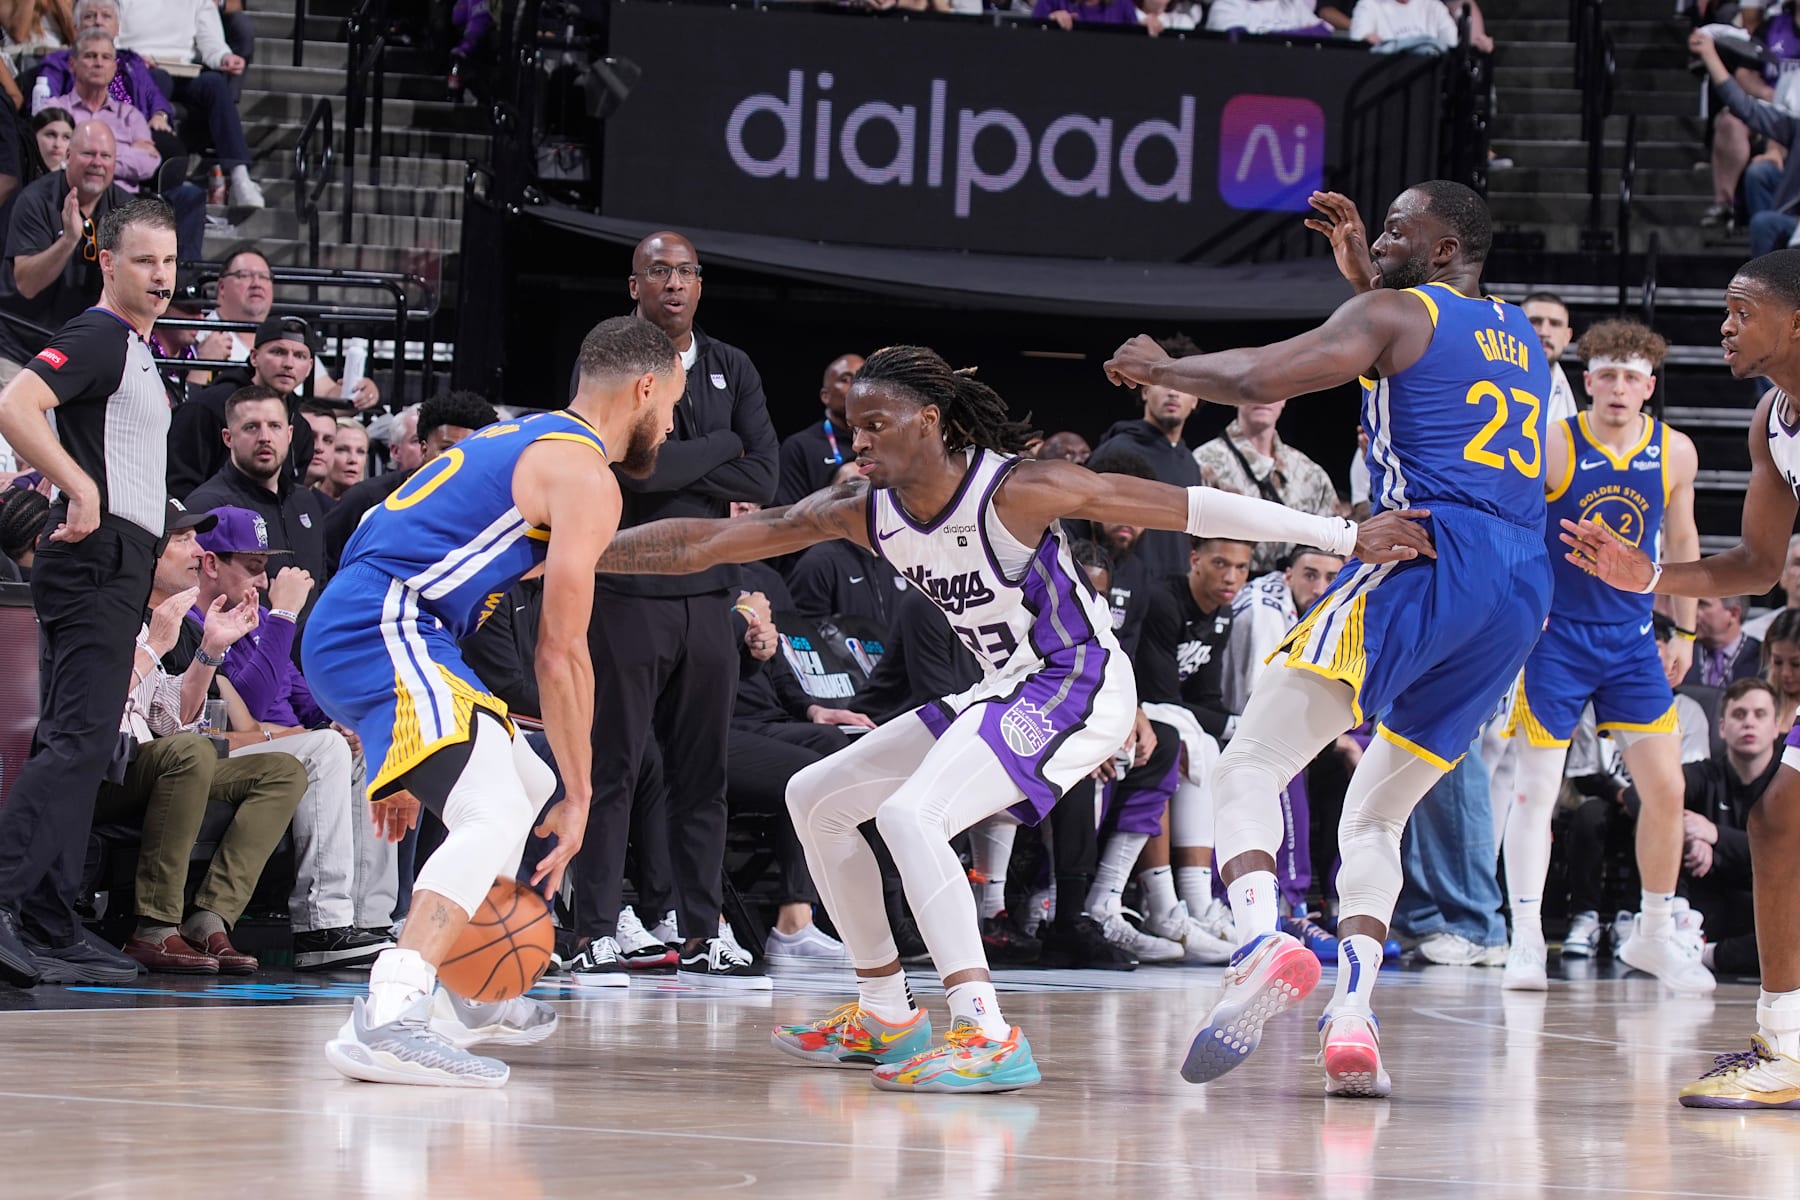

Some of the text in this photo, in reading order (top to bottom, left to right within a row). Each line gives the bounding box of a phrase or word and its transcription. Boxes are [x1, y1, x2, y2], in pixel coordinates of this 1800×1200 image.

[726, 69, 1196, 217] dialpad
[1474, 328, 1529, 372] GREEN
[1463, 380, 1541, 479] 23
[1578, 485, 1650, 512] GOLDEN STATE
[943, 524, 977, 534] dialpad
[1619, 513, 1633, 534] 2
[902, 565, 996, 616] Kings
[1005, 709, 1042, 752] KINGS
